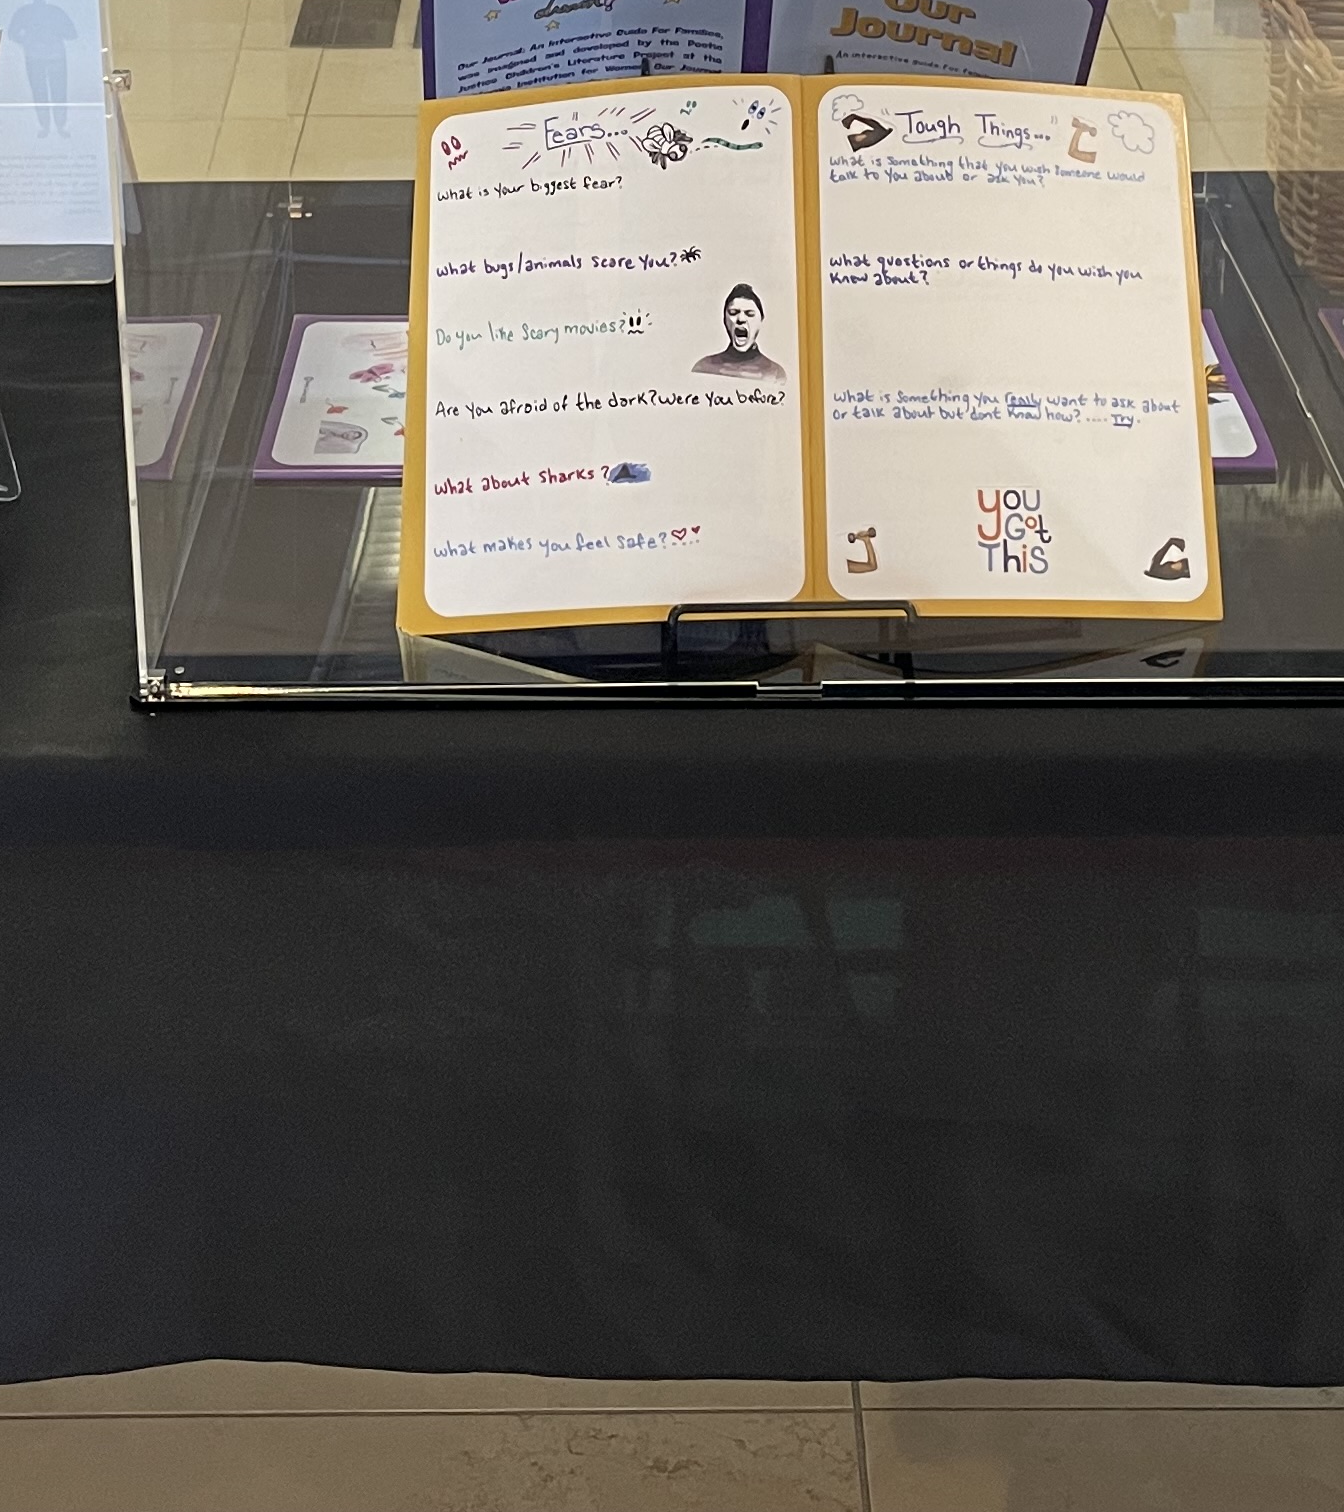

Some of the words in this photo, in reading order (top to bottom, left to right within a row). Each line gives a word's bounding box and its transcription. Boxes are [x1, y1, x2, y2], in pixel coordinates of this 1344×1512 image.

[830, 7, 1018, 68] Journal
[458, 61, 478, 71] Our
[530, 44, 545, 52] An
[458, 71, 479, 81] was
[545, 49, 565, 59] and
[573, 40, 629, 55] developed
[638, 39, 652, 47] by
[836, 50, 849, 59] An
[458, 78, 497, 93] Justice
[568, 53, 625, 67] Literature
[704, 54, 722, 64] the
[581, 65, 598, 75] for
[830, 168, 858, 183] talk
[864, 168, 879, 181] to
[914, 170, 953, 182] about
[963, 173, 978, 182] or
[987, 173, 1010, 184] ask
[871, 157, 882, 167] is
[959, 156, 987, 171] that
[1021, 164, 1050, 175] wish
[1107, 172, 1144, 183] would
[478, 185, 489, 197] is
[530, 177, 576, 196] biggest
[583, 175, 623, 190] fear?
[873, 270, 929, 286] about?
[959, 258, 973, 269] or
[977, 255, 1021, 279] things
[1029, 260, 1043, 274] do
[1048, 263, 1074, 281] you
[1078, 266, 1112, 278] wish
[1116, 270, 1143, 286] you
[436, 328, 451, 345] Do
[456, 330, 482, 350] you
[489, 321, 513, 342] like
[564, 319, 625, 335] movies?
[435, 400, 459, 417] Are
[553, 395, 567, 412] of
[576, 392, 602, 410] the
[736, 389, 785, 407] before?
[855, 406, 884, 420] talk
[893, 406, 934, 420] about
[940, 406, 963, 419] but
[880, 390, 891, 402] is
[1005, 390, 1042, 412] really
[1046, 394, 1087, 407] want
[1094, 393, 1106, 406] to
[1111, 398, 1136, 409] ask
[1142, 398, 1181, 413] about
[481, 471, 529, 491] about
[483, 536, 532, 553] makes
[539, 539, 572, 557] you
[576, 533, 609, 551] feel
